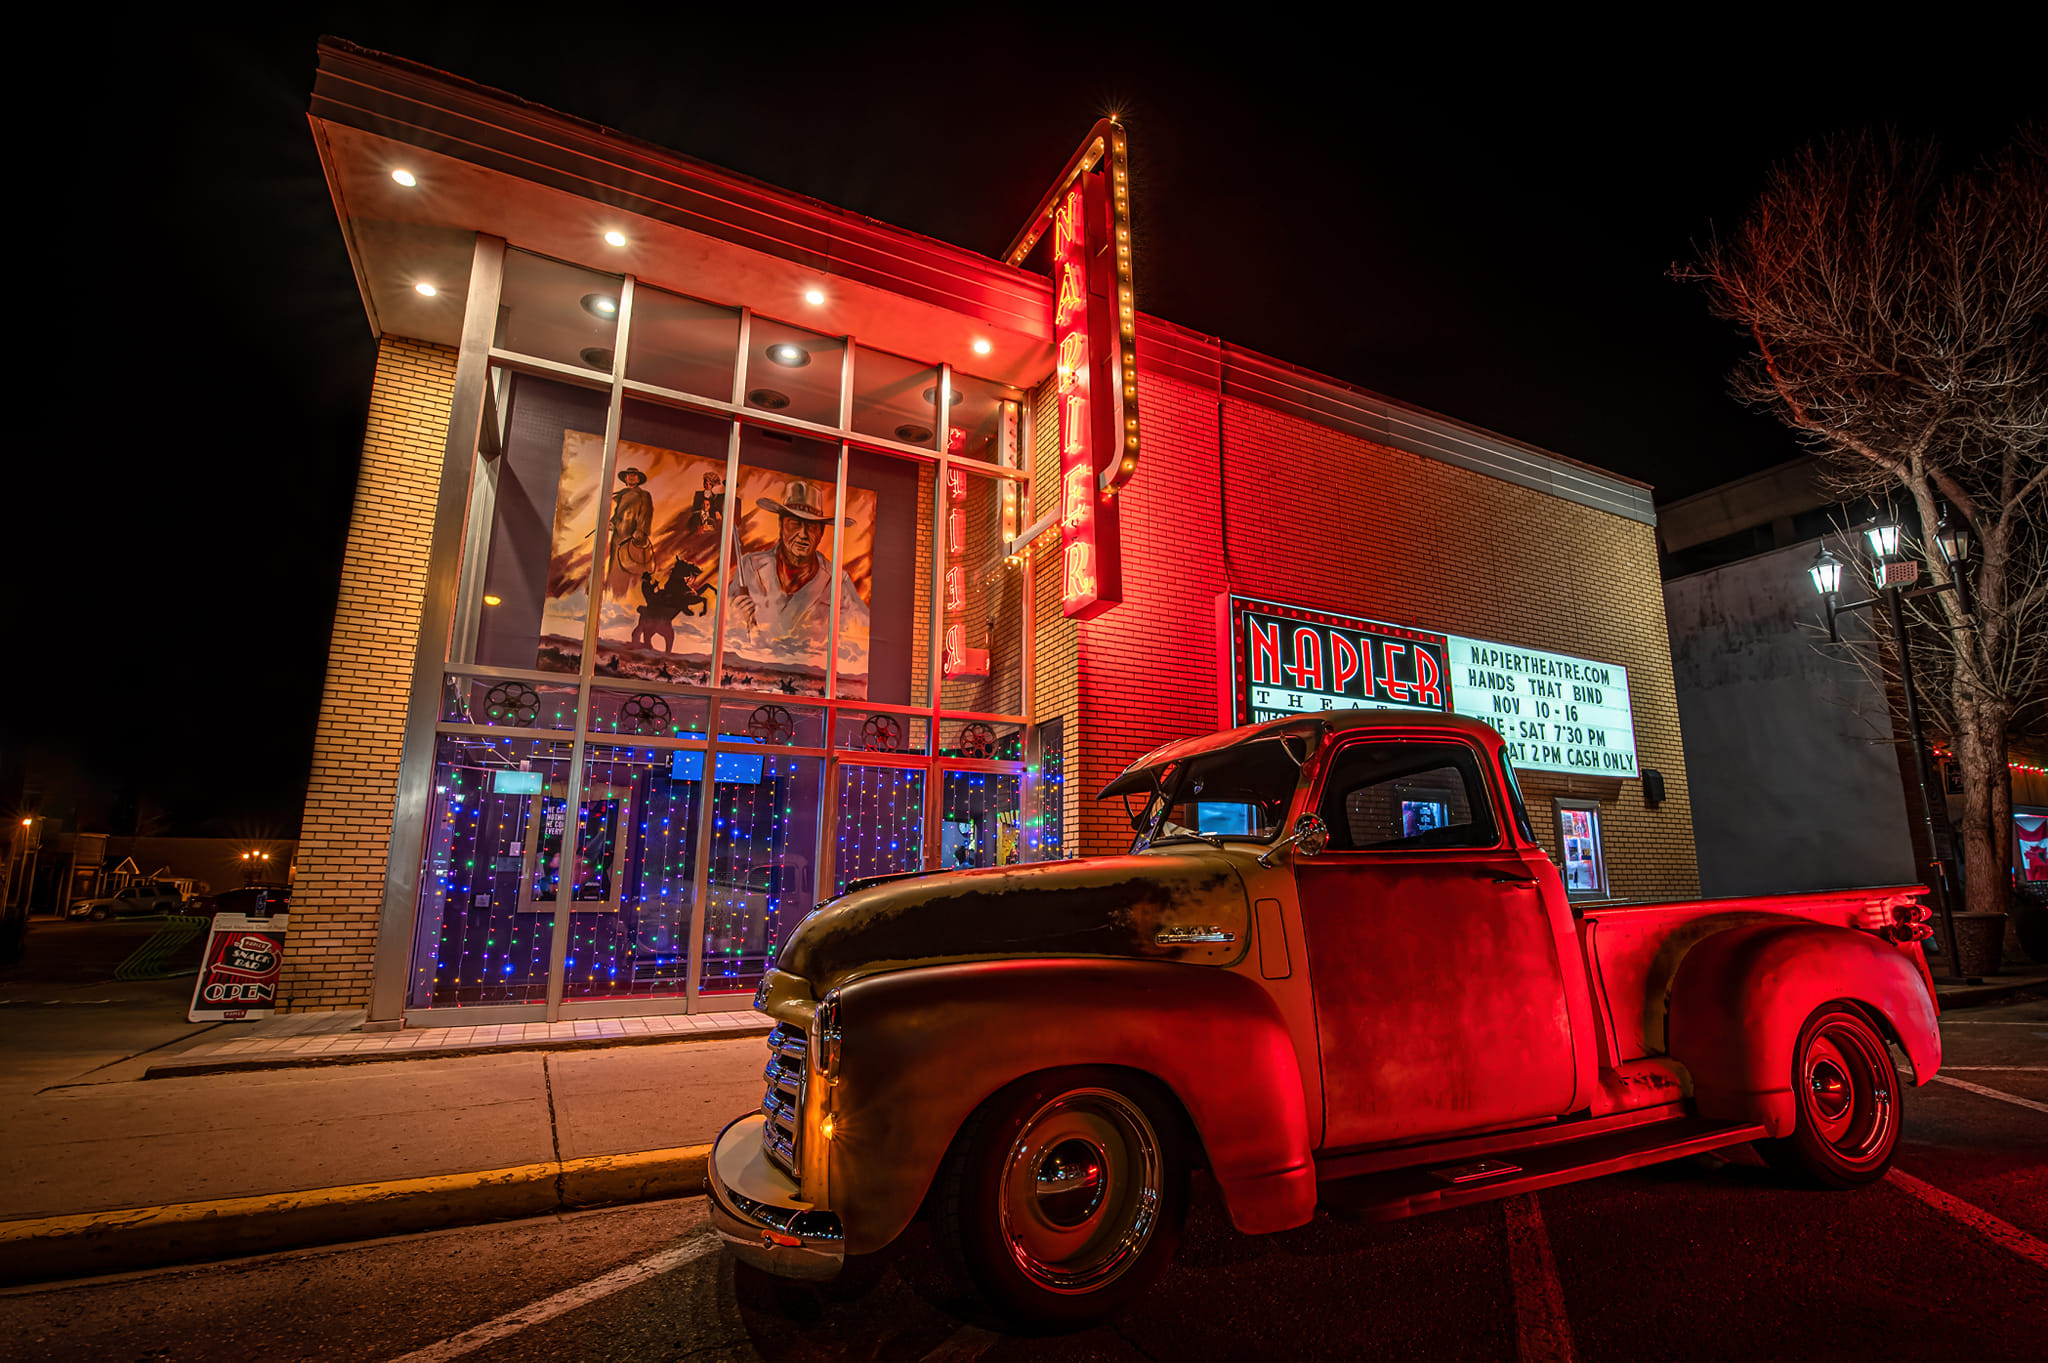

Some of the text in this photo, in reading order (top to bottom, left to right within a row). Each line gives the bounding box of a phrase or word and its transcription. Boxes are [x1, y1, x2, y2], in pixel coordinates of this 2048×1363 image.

[1054, 191, 1090, 601] NAPIER
[1249, 614, 1442, 707] NAPIER
[1470, 646, 1611, 686] NAPIERTHEATRE.COM
[1468, 668, 1604, 706] HANDS THAT BIND
[1492, 694, 1521, 715] NOV
[1535, 700, 1550, 719] 10
[1565, 704, 1579, 722] 16
[1519, 721, 1546, 741] SAT
[1588, 728, 1606, 748] PM
[1567, 748, 1600, 768] CASH
[1603, 752, 1634, 771] ONLY
[232, 949, 272, 963] SNACK
[234, 958, 260, 970] BAR
[204, 982, 275, 1001] OPEN
